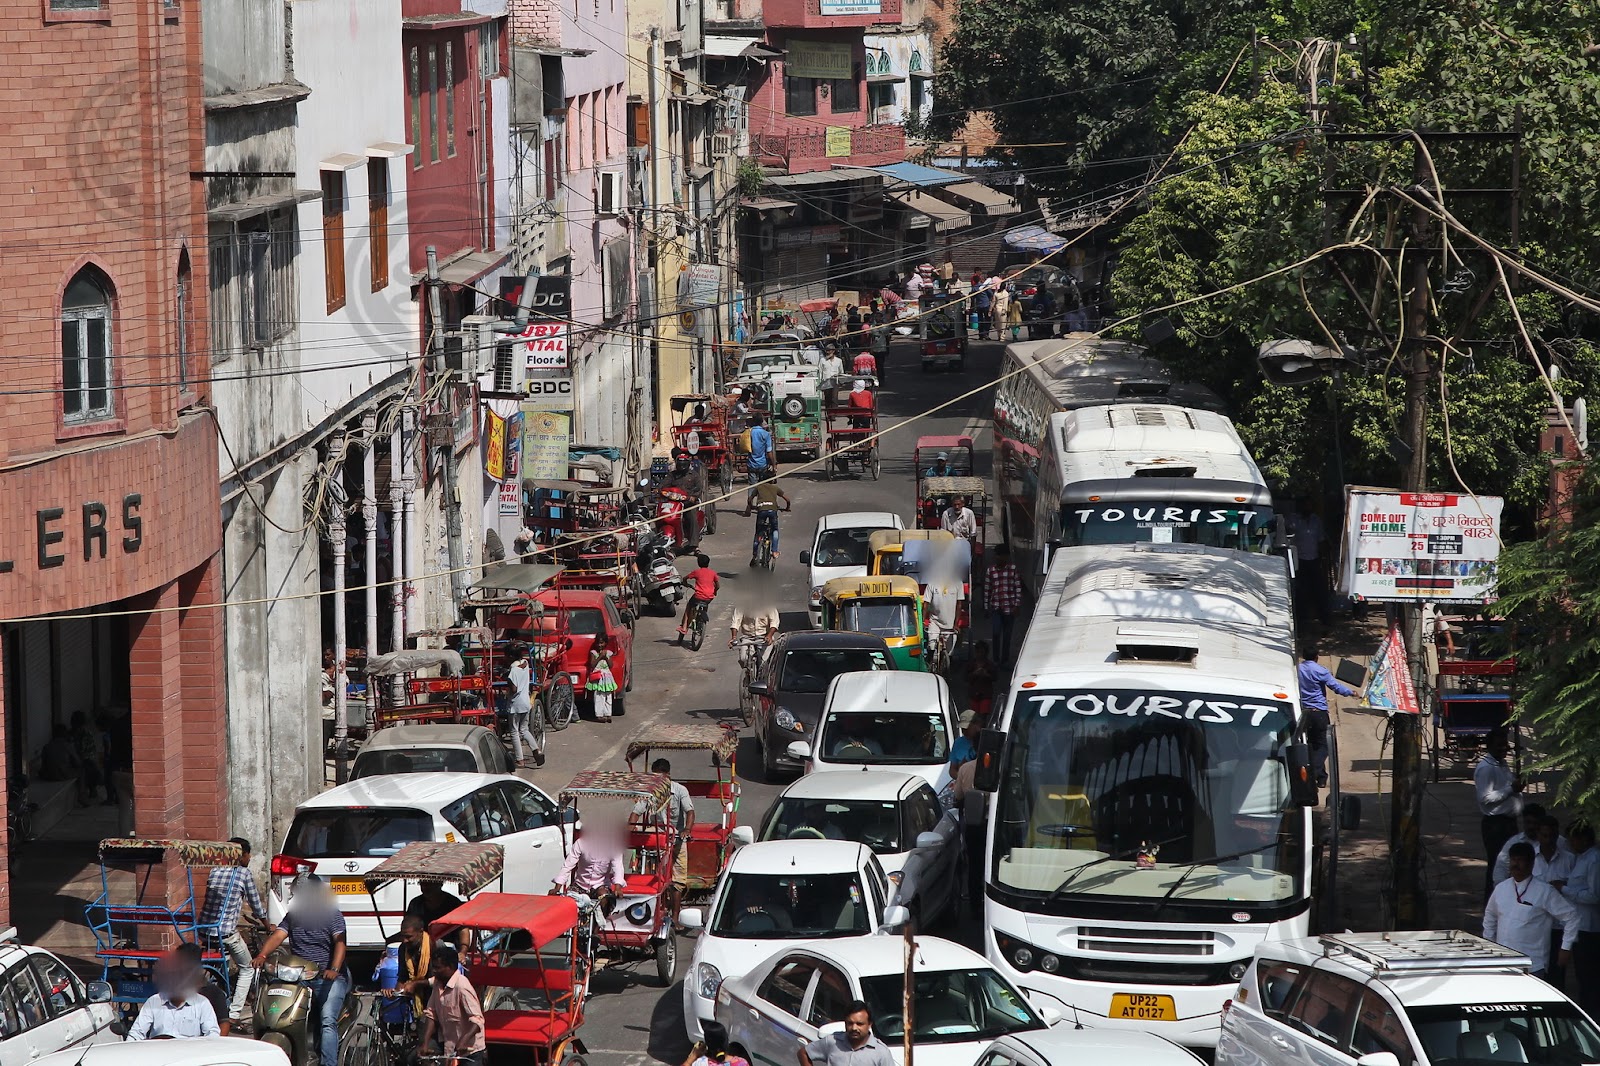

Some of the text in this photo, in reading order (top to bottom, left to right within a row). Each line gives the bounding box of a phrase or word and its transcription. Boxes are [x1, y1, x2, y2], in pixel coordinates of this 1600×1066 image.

[517, 292, 565, 306] DC
[506, 325, 561, 337] UBY
[527, 355, 554, 365] Floor
[529, 381, 571, 394] GDC
[500, 484, 517, 493] UBY
[1075, 507, 1257, 524] TOURIST
[1361, 513, 1406, 523] COME OUT
[1371, 523, 1407, 532] HOME
[1463, 527, 1493, 539] बाहर
[1411, 541, 1424, 551] 25
[872, 583, 888, 594] DUTY
[1028, 695, 1278, 727] TOURIST
[351, 884, 357, 892] B
[1130, 995, 1158, 1006] UP22
[1122, 1007, 1164, 1018] AT 0127
[1461, 1004, 1528, 1013] TOURIST
